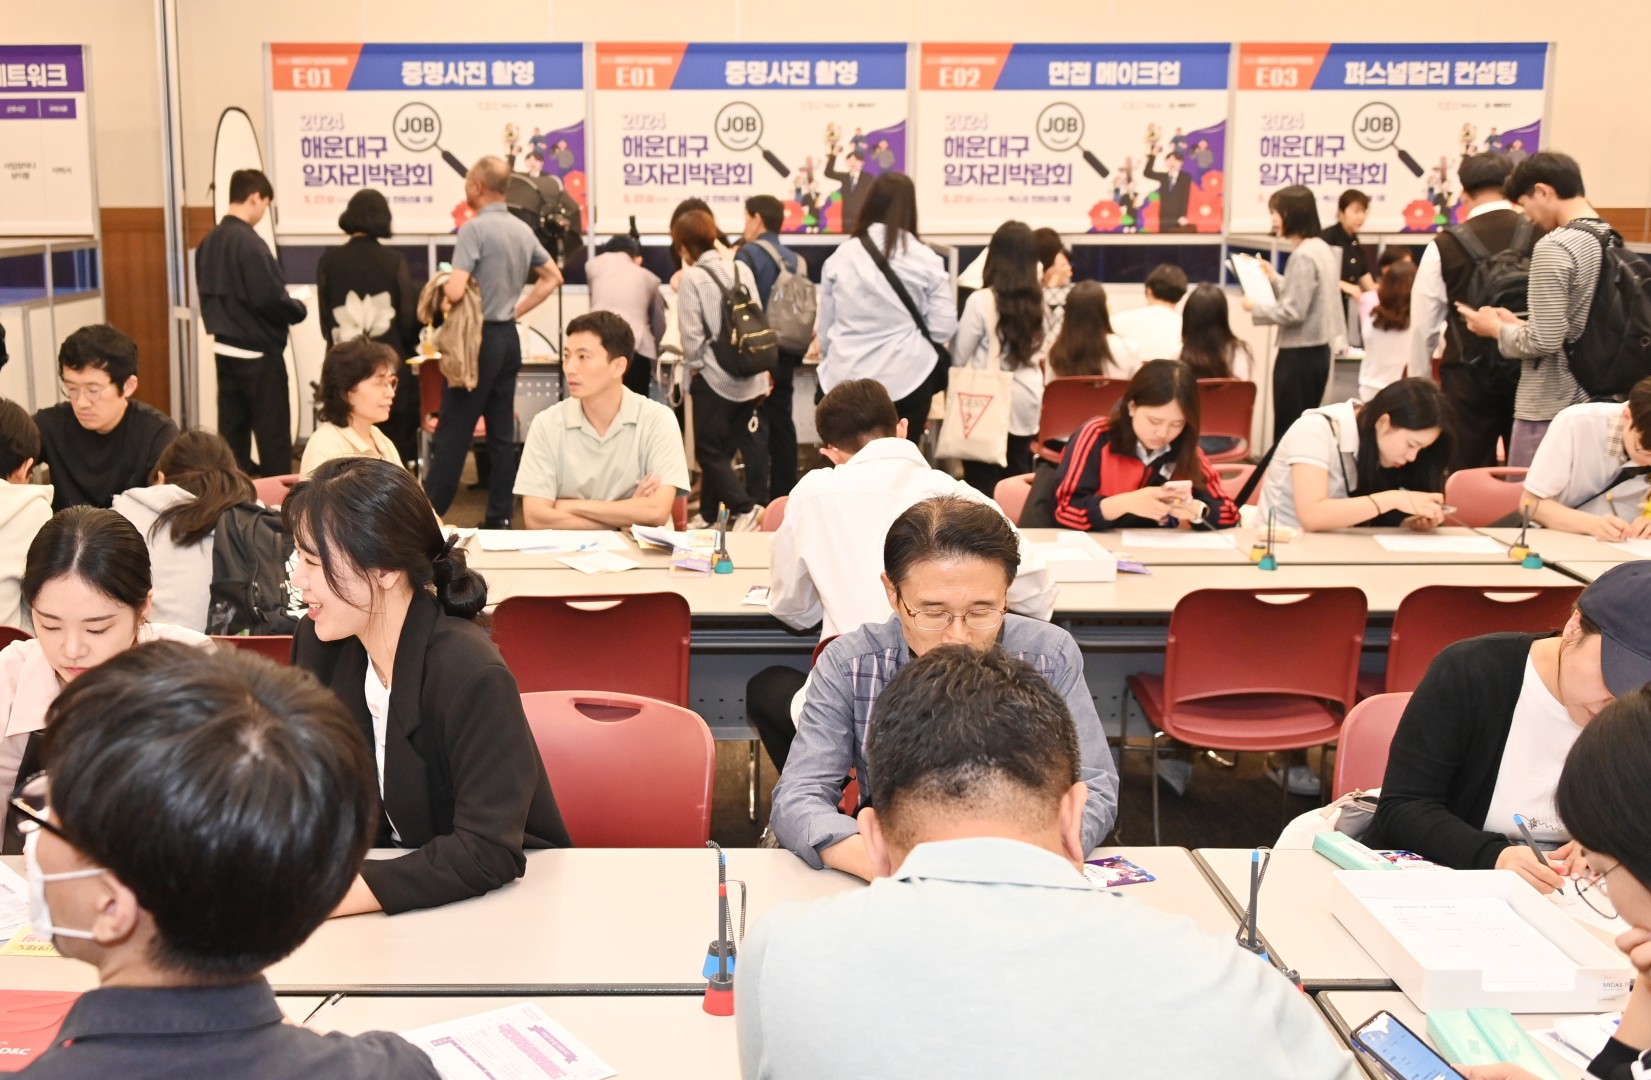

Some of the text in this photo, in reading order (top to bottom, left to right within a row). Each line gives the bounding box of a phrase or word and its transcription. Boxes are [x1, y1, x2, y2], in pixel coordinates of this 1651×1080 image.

[292, 67, 333, 88] E01
[401, 61, 535, 86] 증명사진 촬영
[616, 66, 656, 88] E01
[725, 60, 859, 86] 증명사진 촬영
[938, 67, 981, 88] E02
[1048, 60, 1181, 86] 면접 메이크업
[1255, 67, 1298, 88] E03
[1344, 60, 1518, 86] 퍼스널컬러 컨설팅
[299, 112, 344, 132] 2024
[400, 117, 435, 133] JOB
[622, 112, 667, 131] 2024
[722, 117, 757, 133] JOB
[944, 112, 988, 131] 2024
[1043, 116, 1079, 133] JOB
[1260, 112, 1305, 131] 2024
[1359, 116, 1394, 133] JOB
[301, 136, 388, 159] 해운대구
[622, 135, 709, 158] 해운대구
[944, 135, 1030, 158] 해운대구
[1259, 135, 1345, 157] 해운대구
[302, 163, 433, 187] 일자리박람회
[623, 163, 753, 186] 일자리박람회
[944, 163, 1073, 186] 일자리박람회
[1259, 162, 1387, 185] 일자리박람회
